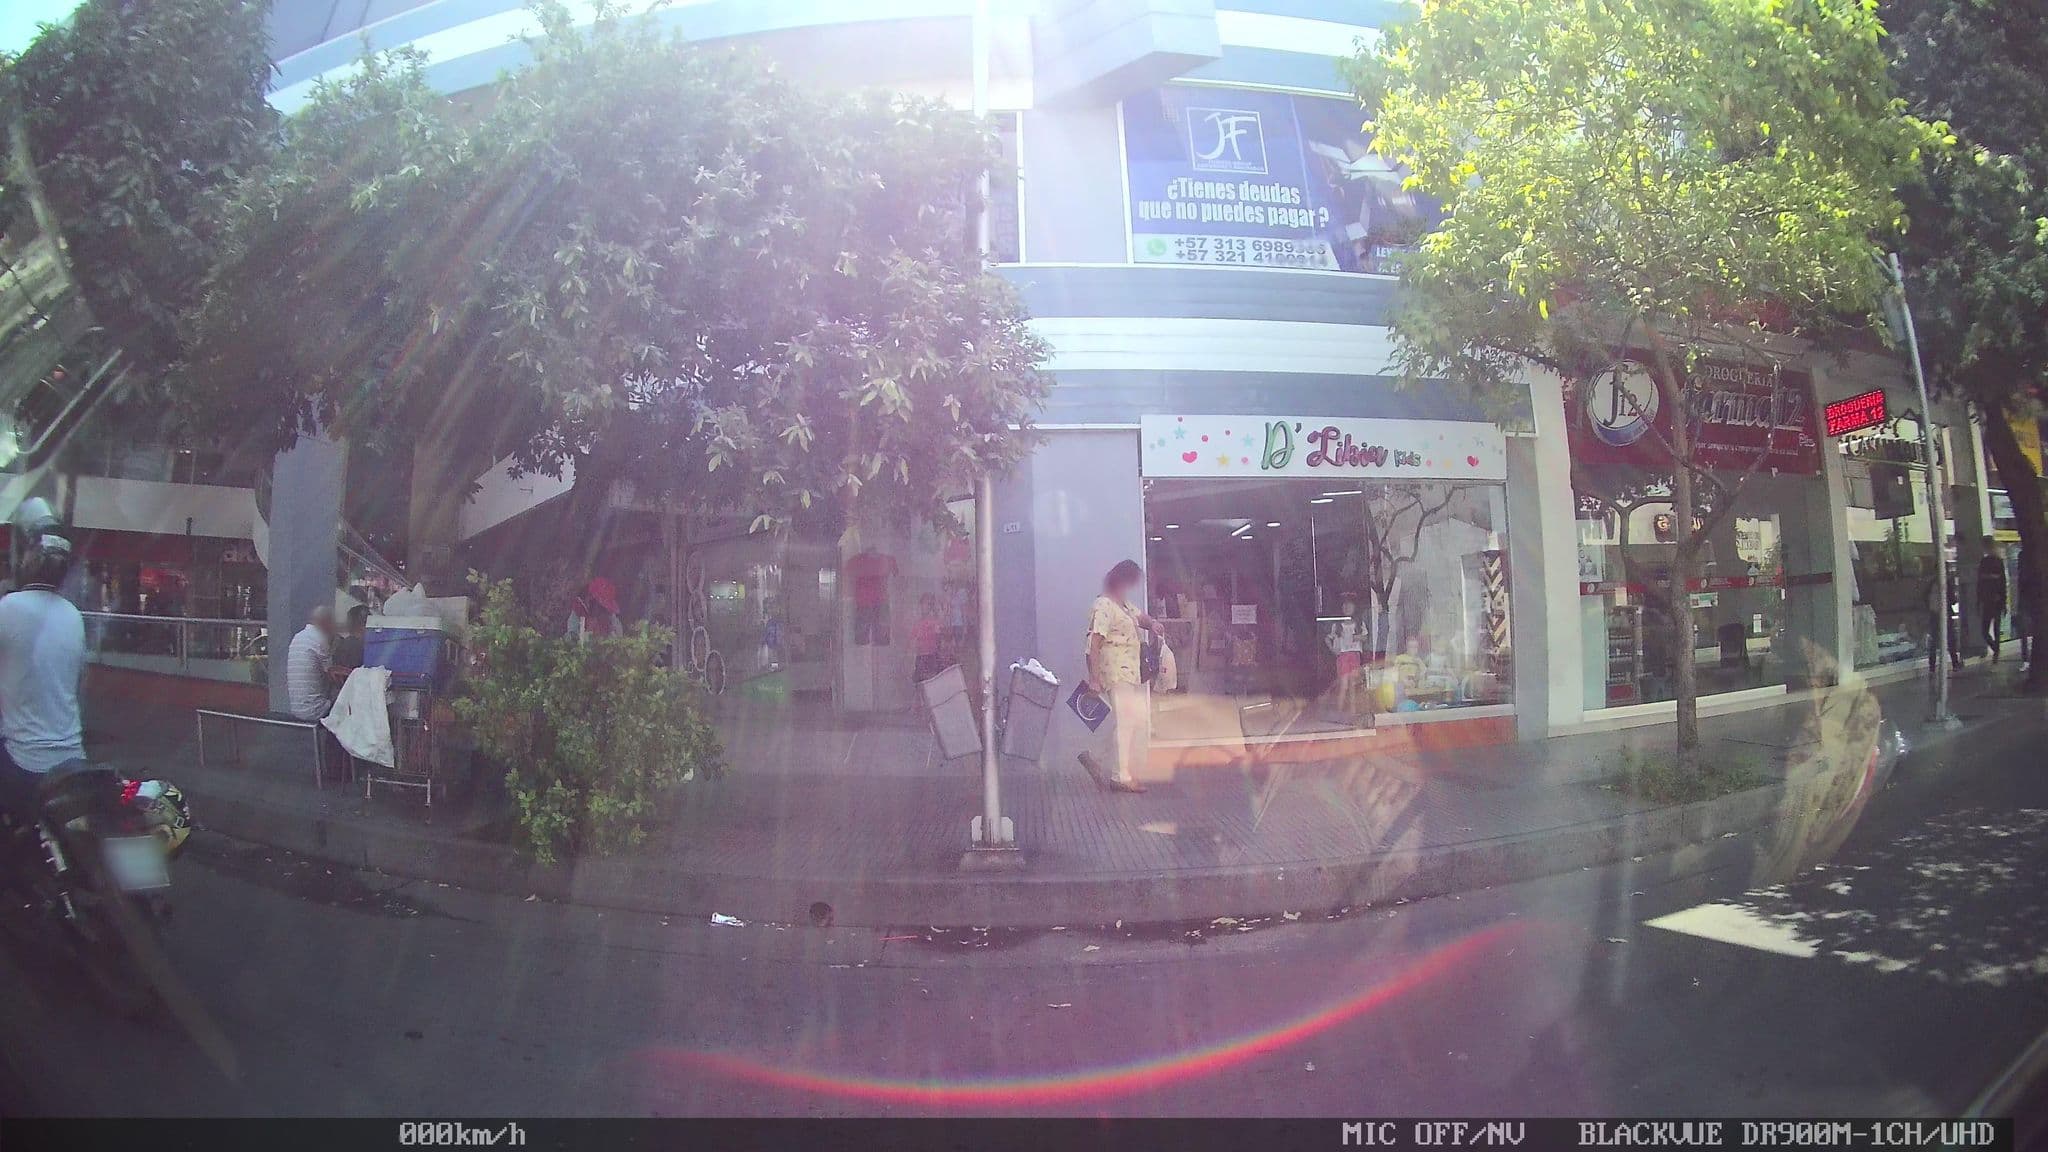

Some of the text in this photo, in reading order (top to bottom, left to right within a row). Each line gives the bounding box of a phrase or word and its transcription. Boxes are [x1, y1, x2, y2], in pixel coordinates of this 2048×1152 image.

[1167, 176, 1301, 205] ¿Tienes deudas
[1138, 200, 1330, 229] que no puedes pagar ?
[1174, 237, 1208, 250] +57
[1213, 238, 1246, 251] 313
[1175, 249, 1209, 262] +57
[1215, 250, 1246, 263] 321
[1829, 405, 1885, 434] FARMA 12
[1393, 449, 1422, 468] Kids
